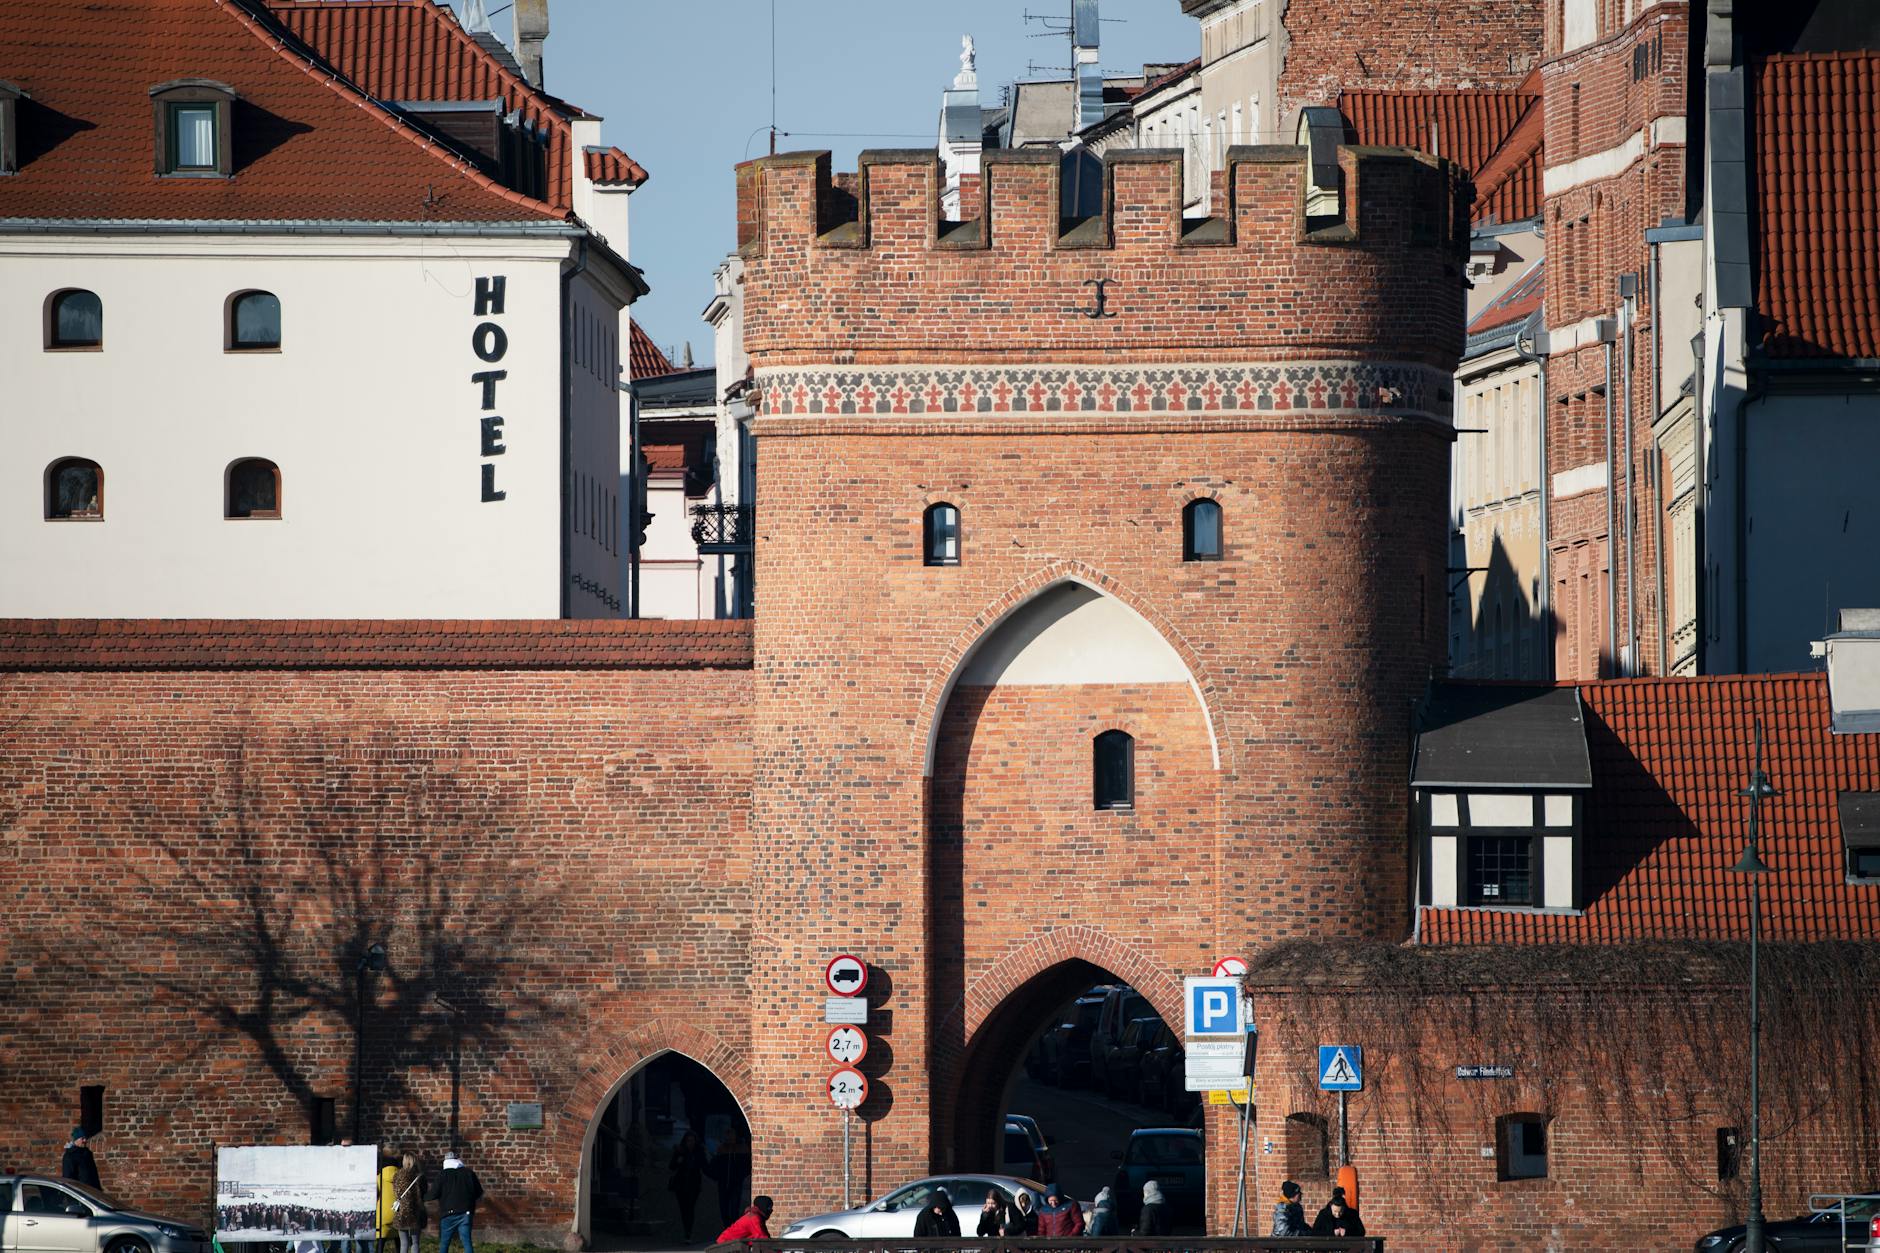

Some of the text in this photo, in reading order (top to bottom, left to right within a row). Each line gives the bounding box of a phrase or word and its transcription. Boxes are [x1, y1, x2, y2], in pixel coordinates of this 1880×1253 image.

[471, 275, 508, 503] HOTEL
[1203, 990, 1228, 1028] P
[833, 1039, 851, 1053] 2,7
[839, 1082, 846, 1093] 2
